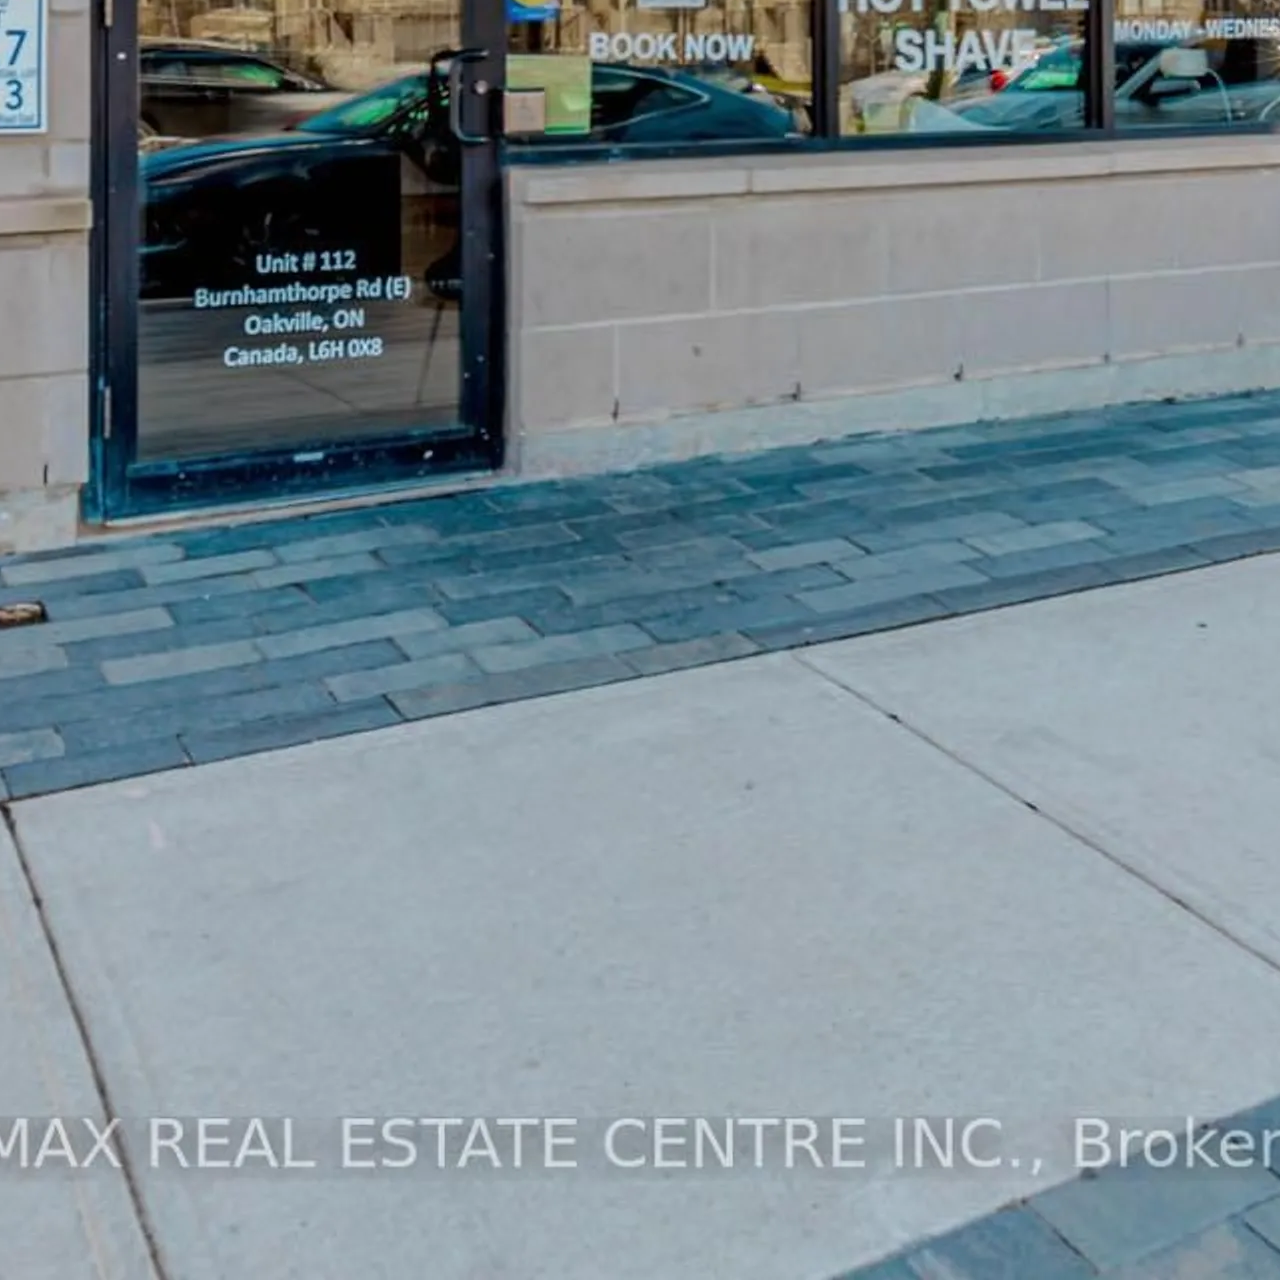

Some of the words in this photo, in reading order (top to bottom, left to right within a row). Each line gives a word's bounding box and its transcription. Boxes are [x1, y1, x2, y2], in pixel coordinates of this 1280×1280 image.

[1113, 19, 1193, 43] MONDAY
[589, 32, 676, 61] BOOK
[684, 33, 755, 61] NOW
[895, 28, 1037, 73] SHAVE
[4, 79, 24, 111] 3
[256, 254, 298, 274] Unit
[302, 254, 316, 271] #
[320, 250, 356, 270] 112
[194, 280, 352, 309] Burnhamthorpe
[356, 277, 381, 298] Rd
[385, 276, 412, 300] (E)
[244, 311, 328, 336] Oakville,
[333, 309, 365, 329] ON
[224, 342, 303, 367] Canada,
[309, 340, 343, 361] L6H
[347, 337, 383, 357] 0X8
